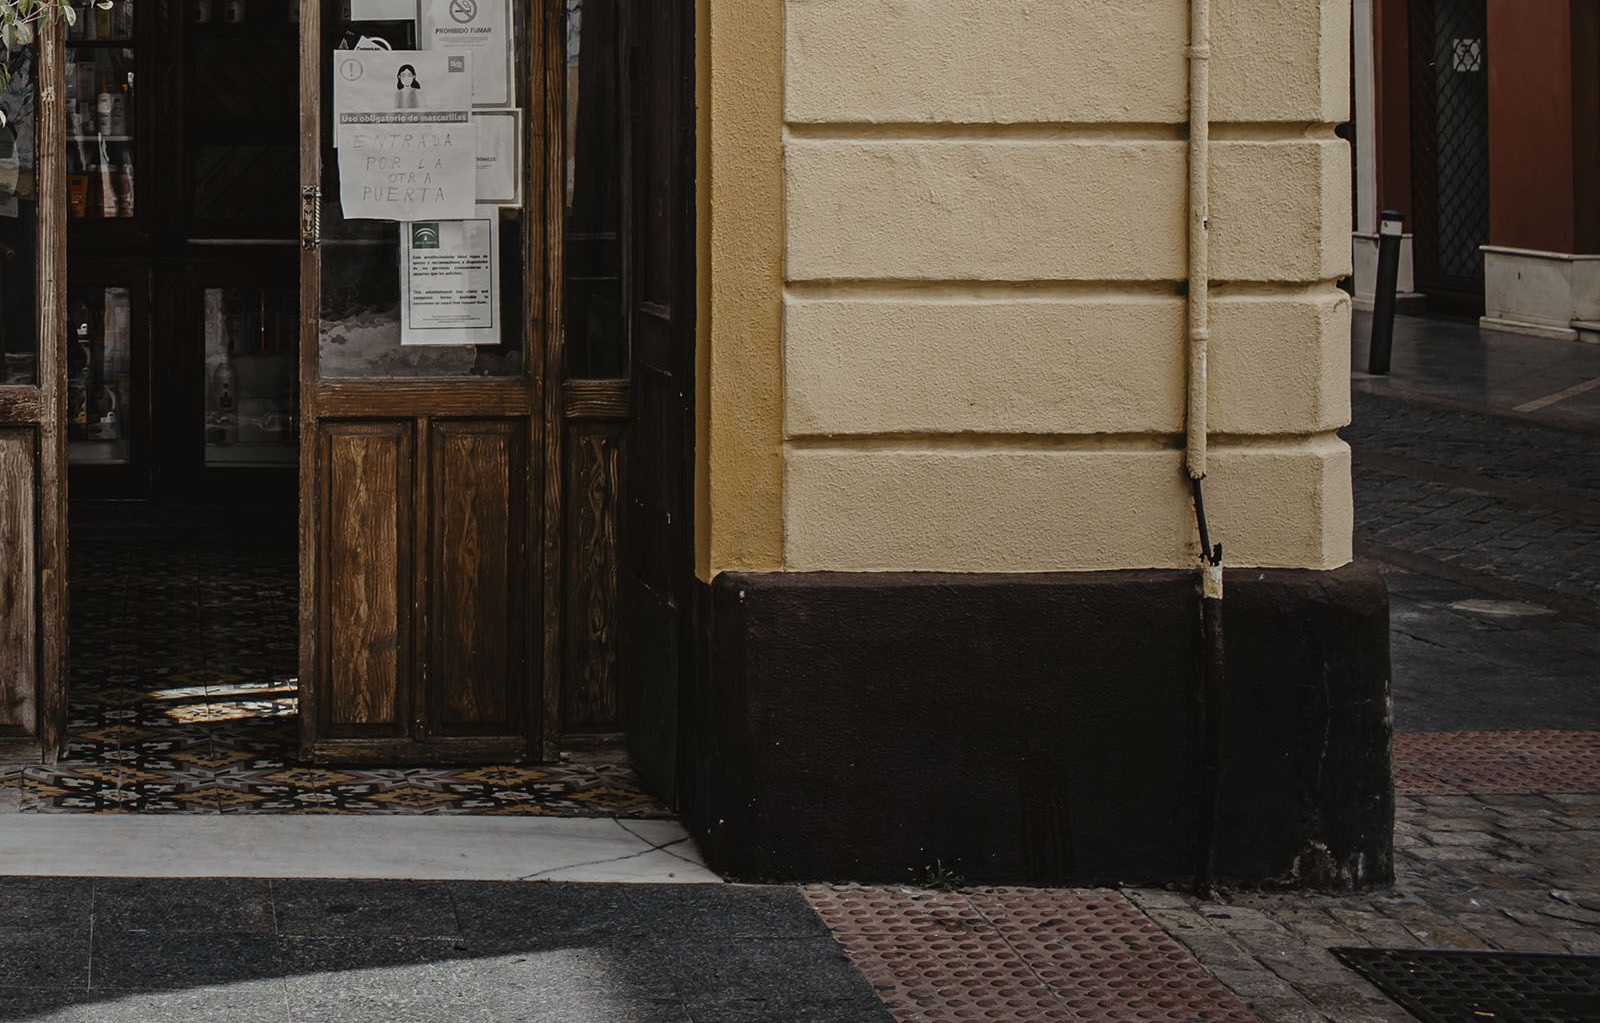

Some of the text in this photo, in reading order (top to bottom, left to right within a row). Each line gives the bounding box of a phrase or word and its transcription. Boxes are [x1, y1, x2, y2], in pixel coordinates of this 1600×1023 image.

[341, 113, 467, 124] Uso obligatorio de mascarillas
[353, 133, 453, 149] ENTRADA
[366, 156, 401, 171] POR
[388, 172, 433, 184] OTRA
[362, 186, 446, 202] PUERTA
